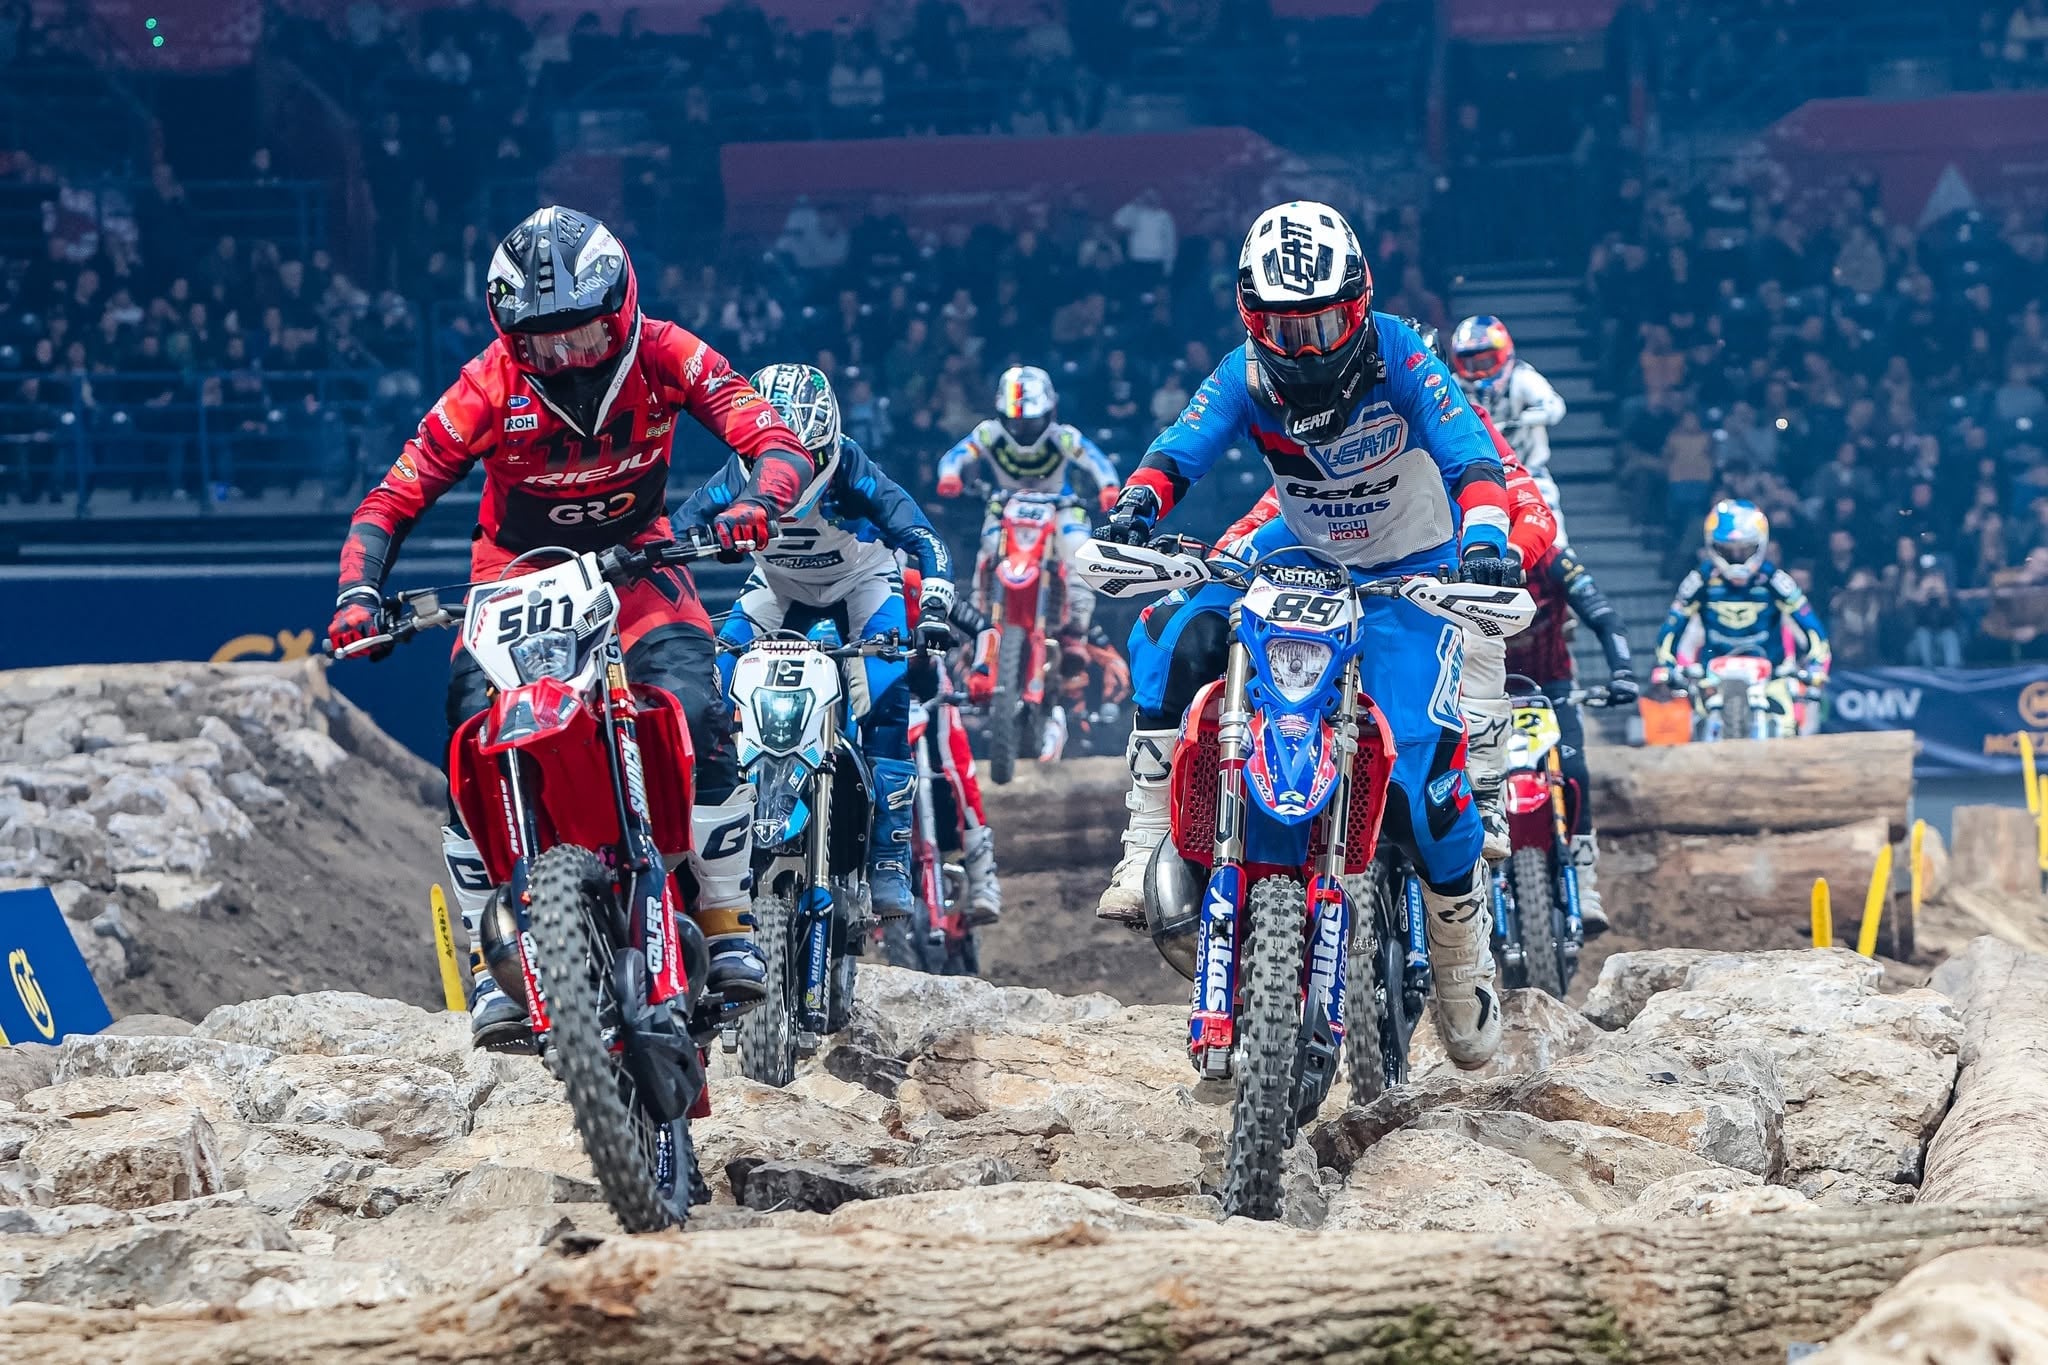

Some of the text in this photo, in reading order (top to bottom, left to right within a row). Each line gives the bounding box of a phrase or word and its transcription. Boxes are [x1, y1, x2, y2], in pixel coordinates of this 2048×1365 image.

[1293, 409, 1335, 434] LEATT
[1323, 423, 1400, 467] LEATT
[524, 448, 663, 485] RIEJU
[1286, 475, 1399, 500] Beta
[1304, 499, 1390, 518] Mitas
[1329, 520, 1366, 531] LIQUI
[1331, 530, 1369, 540] MOLY
[1088, 563, 1144, 576] Polisport
[1271, 569, 1327, 585] ASTRA
[498, 594, 574, 645] 501
[1265, 593, 1344, 627] 89
[1466, 604, 1521, 620] Polisport
[1836, 688, 1923, 721] OMV
[621, 733, 649, 822] SHOCK
[1254, 774, 1271, 801] Beta
[1310, 778, 1329, 804] Beta
[1409, 880, 1423, 948] MICHELIN
[810, 922, 823, 983] MICHELIN
